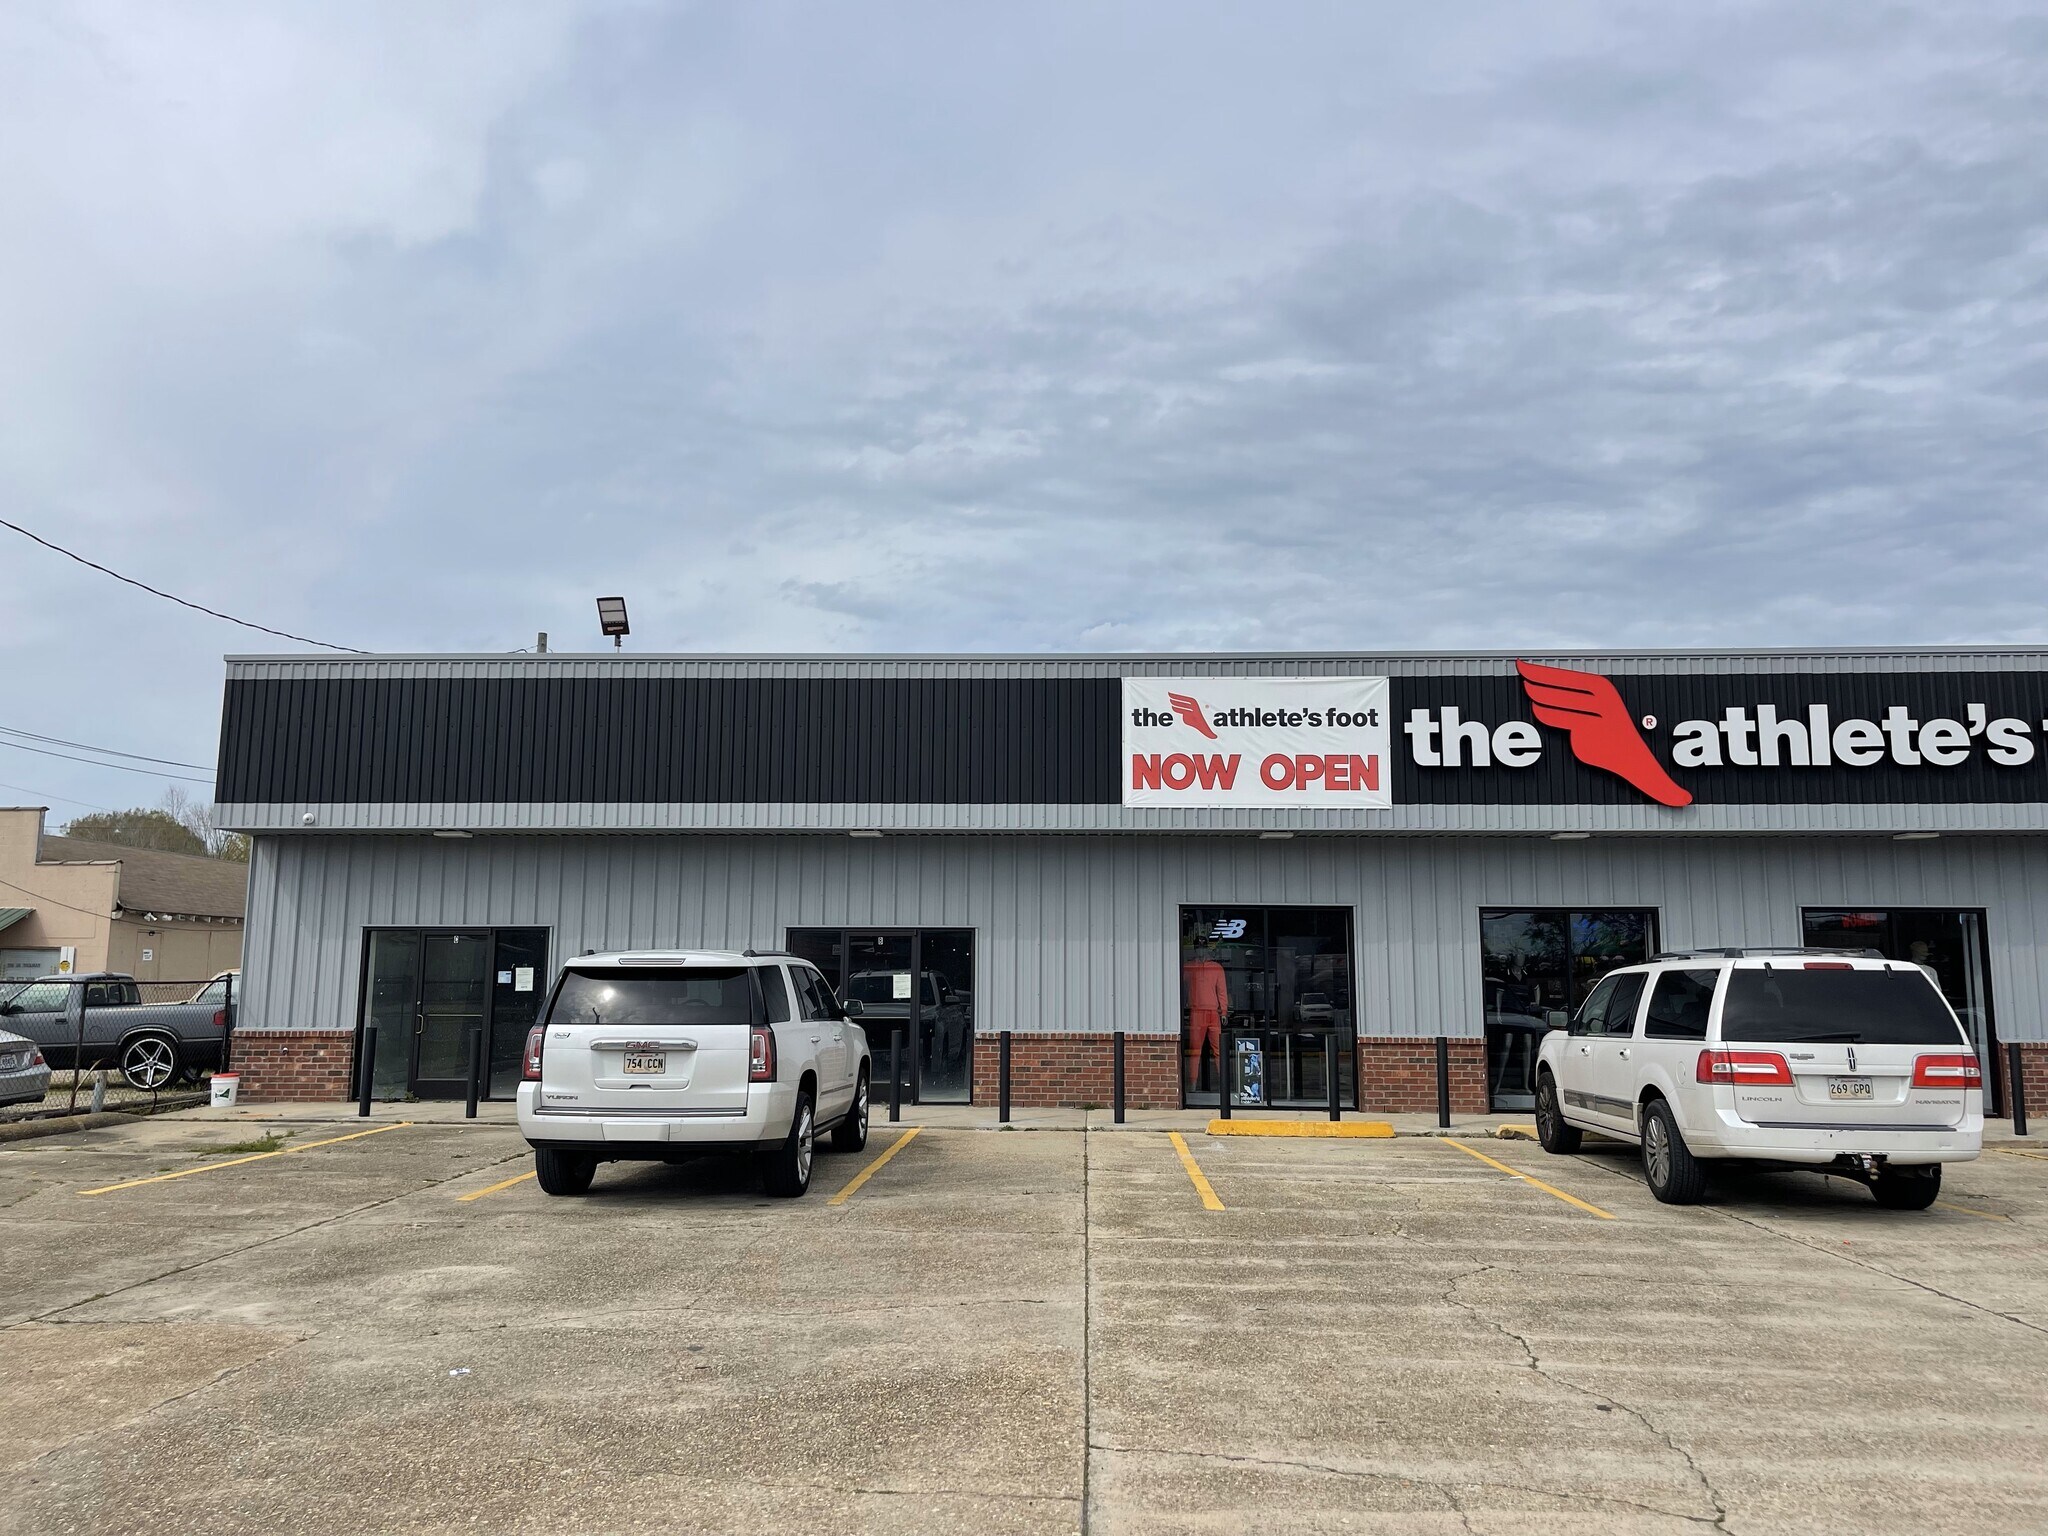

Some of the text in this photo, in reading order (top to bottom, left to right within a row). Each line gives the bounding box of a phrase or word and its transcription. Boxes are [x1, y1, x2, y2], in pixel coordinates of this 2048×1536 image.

[1132, 708, 1378, 727] the athlete's foot
[1404, 706, 1542, 766] the
[1672, 703, 2035, 766] athlete's
[1132, 753, 1380, 791] NOW OPEN
[626, 1041, 660, 1049] GMC
[627, 1058, 664, 1068] 754 CCN
[1830, 1083, 1871, 1094] 269 GPQ
